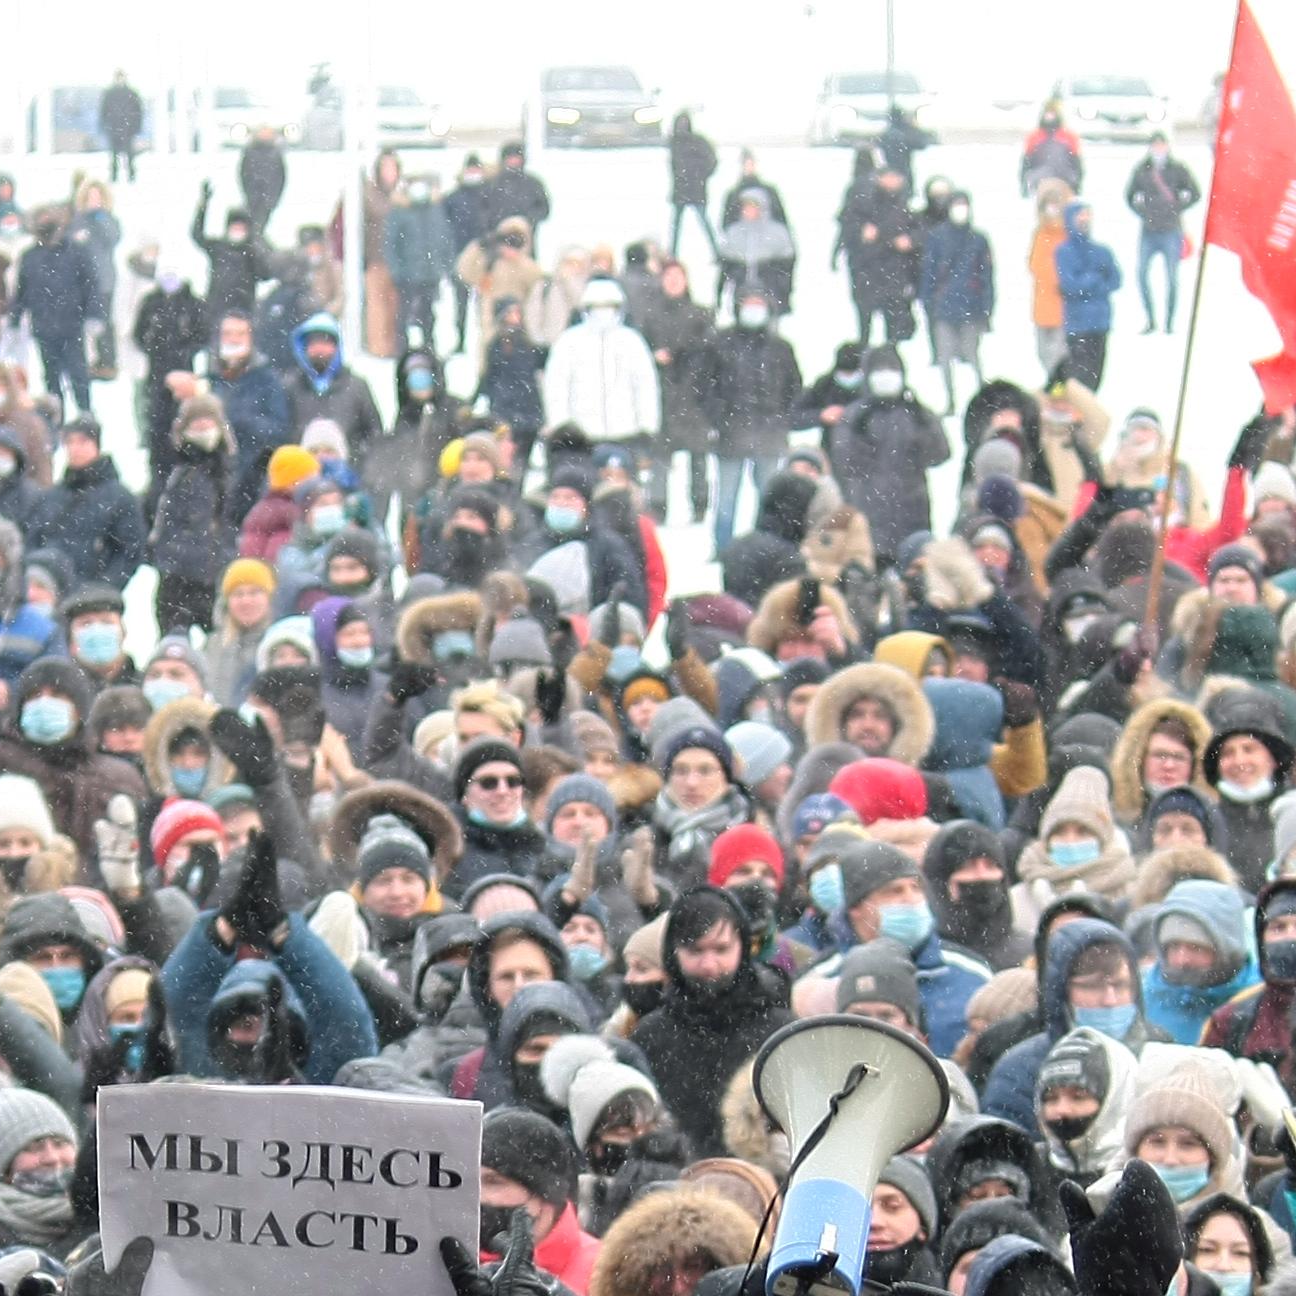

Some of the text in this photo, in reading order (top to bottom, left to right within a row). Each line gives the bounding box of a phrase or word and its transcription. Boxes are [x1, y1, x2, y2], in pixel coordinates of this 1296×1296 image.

[127, 1132, 463, 1192] МЫ ЗДЕСЬ
[164, 1199, 420, 1256] ВЛАСТЬ
